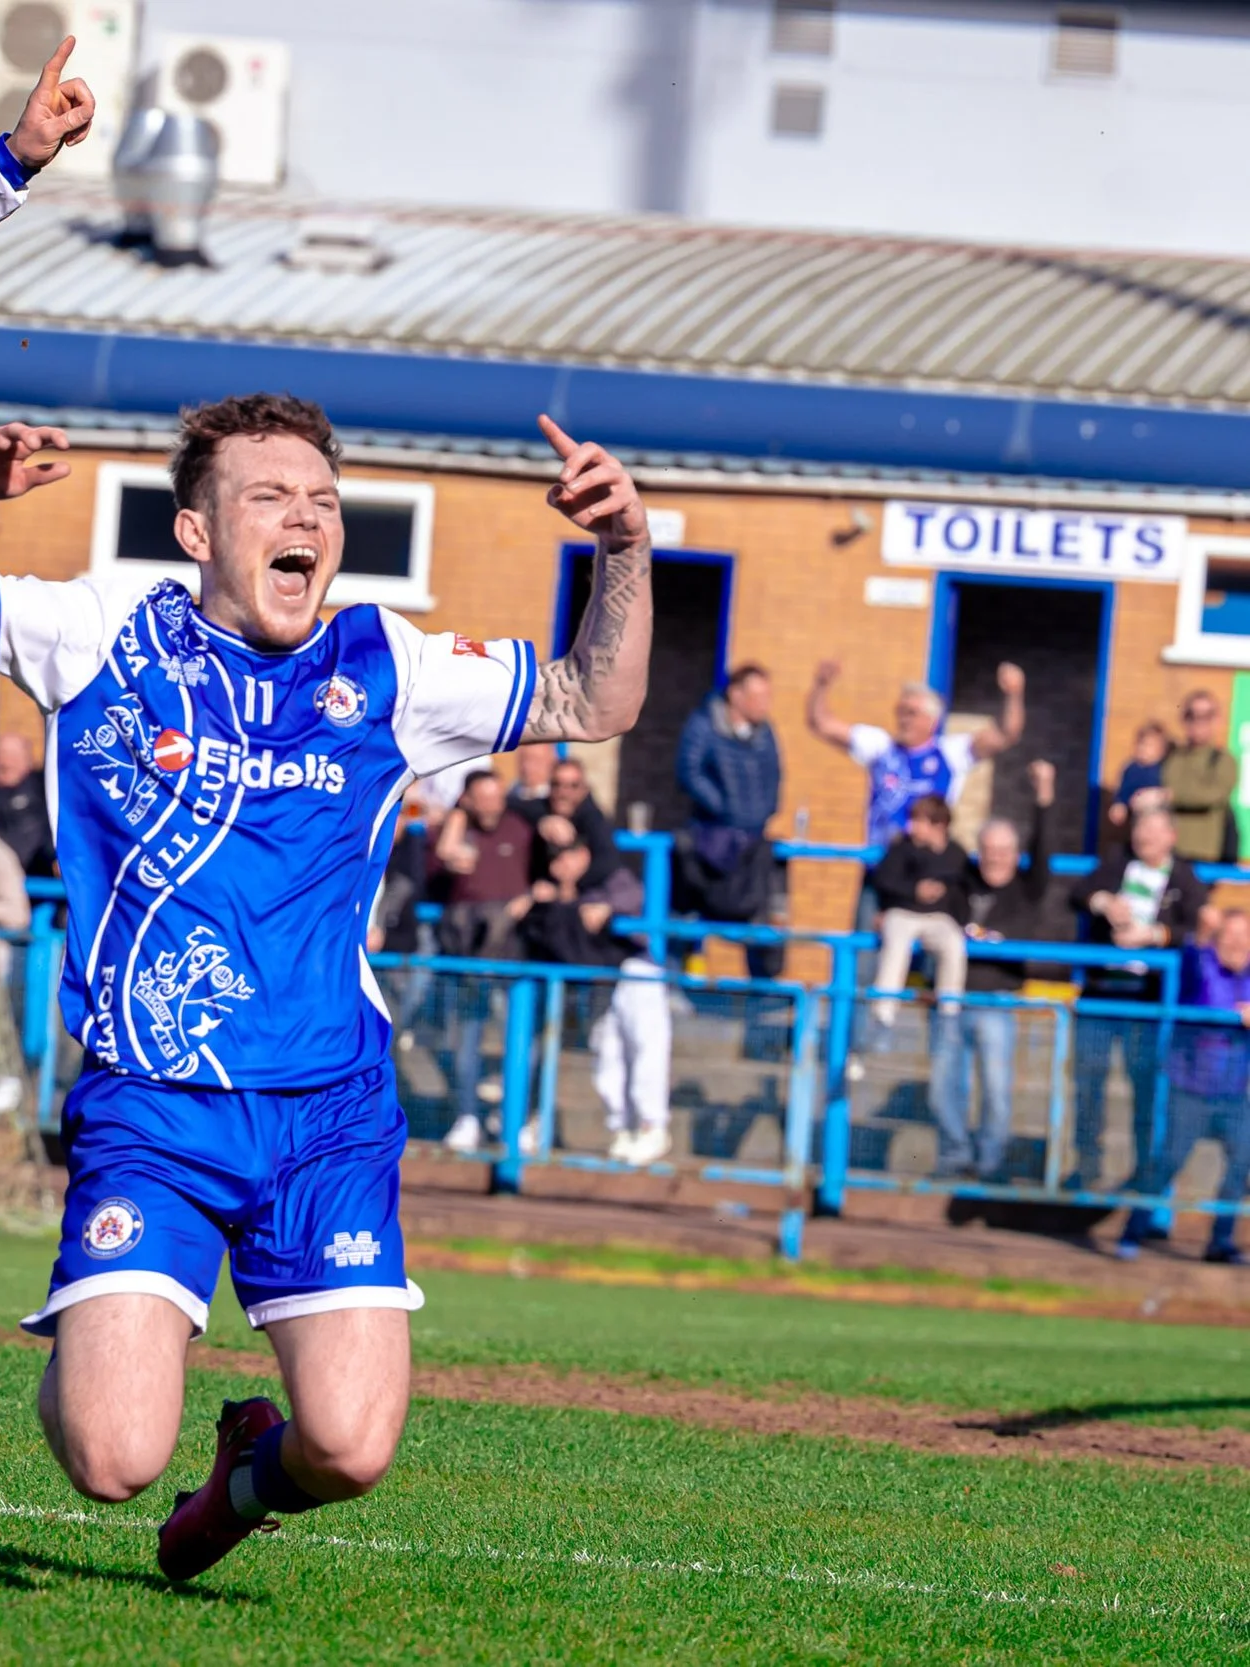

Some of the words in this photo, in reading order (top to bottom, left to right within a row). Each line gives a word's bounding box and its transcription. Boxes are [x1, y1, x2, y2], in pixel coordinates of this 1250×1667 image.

[905, 505, 1166, 566] TOILETS
[243, 675, 274, 726] 11
[195, 736, 346, 794] Fidelis
